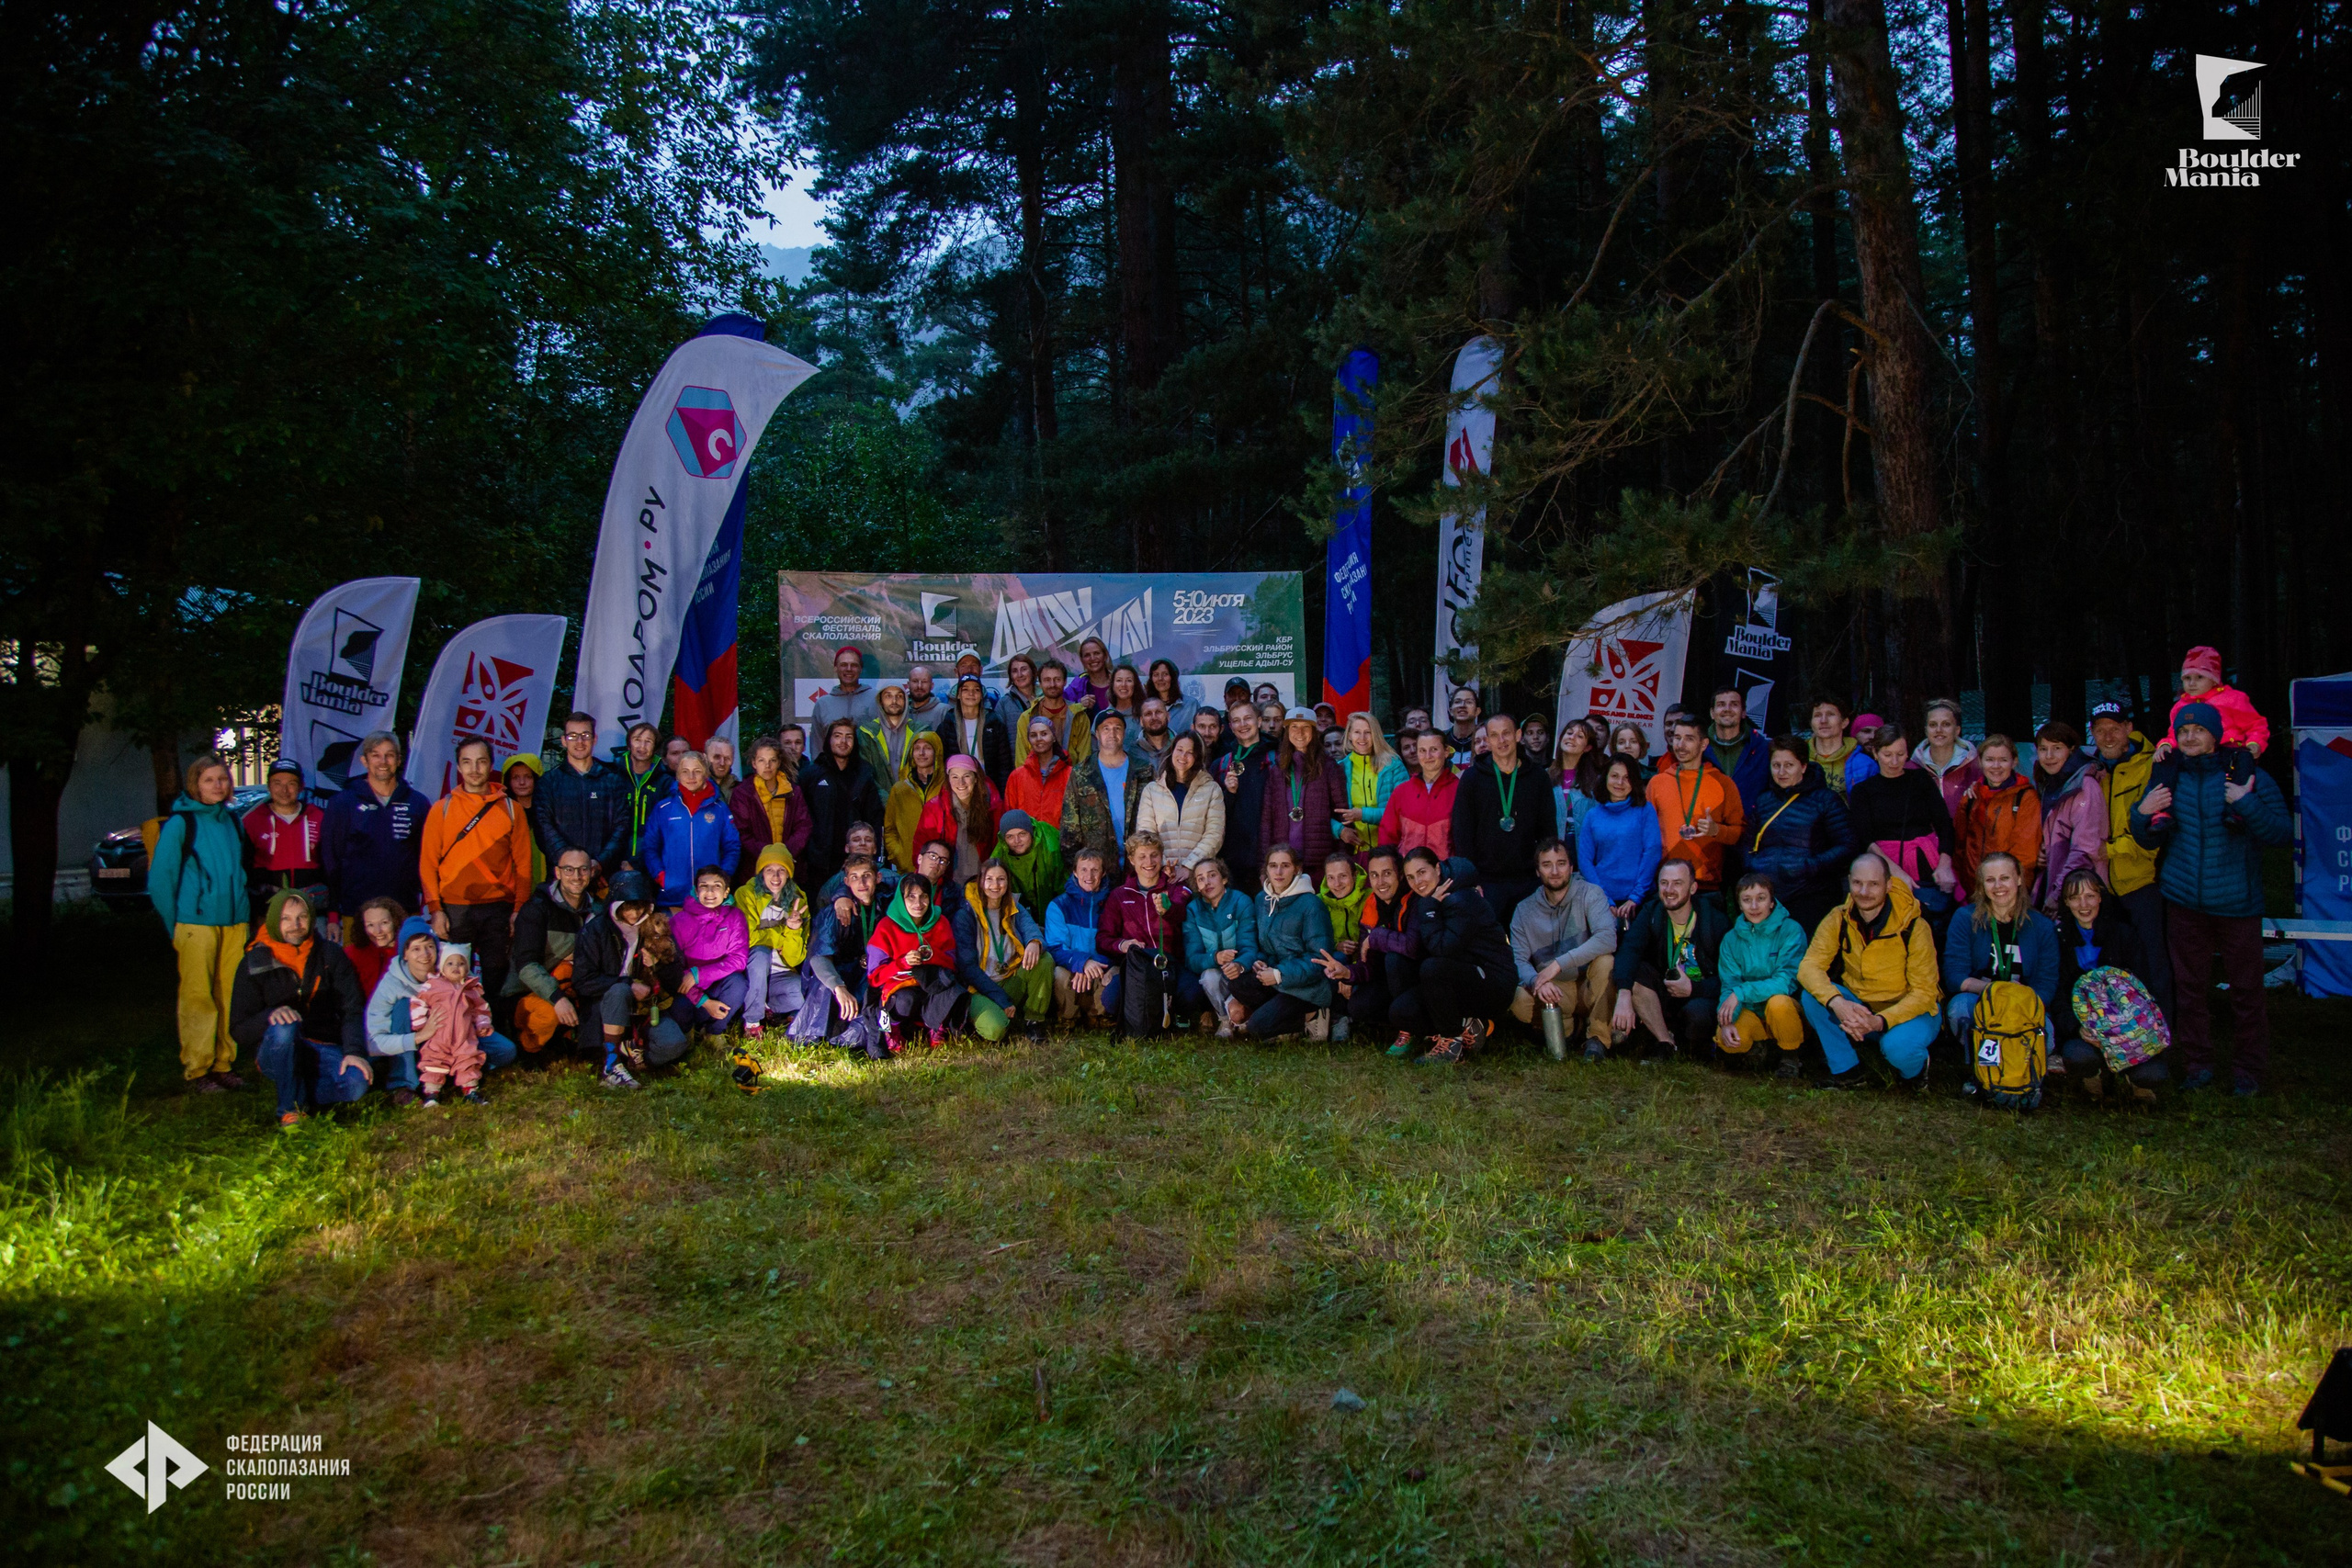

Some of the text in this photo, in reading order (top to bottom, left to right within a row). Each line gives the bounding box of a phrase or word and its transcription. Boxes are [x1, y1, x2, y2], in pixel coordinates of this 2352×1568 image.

[794, 615, 881, 624] ВСЕРОССИЙСКИЙ
[1172, 607, 1215, 625] 2023
[802, 632, 881, 640] СКАЛОЛАЗАНИЯ
[1736, 627, 1791, 649] Boulder
[912, 640, 978, 652] Boulder
[1203, 642, 1293, 653] ЭЛЬБРУССКИЙ РАЙОН
[1727, 638, 1771, 659] Mania
[905, 650, 956, 661] Mania
[1219, 659, 1294, 669] УЩЕЛЬЕ АДЫЛ-СУ
[312, 672, 388, 705] Boulder
